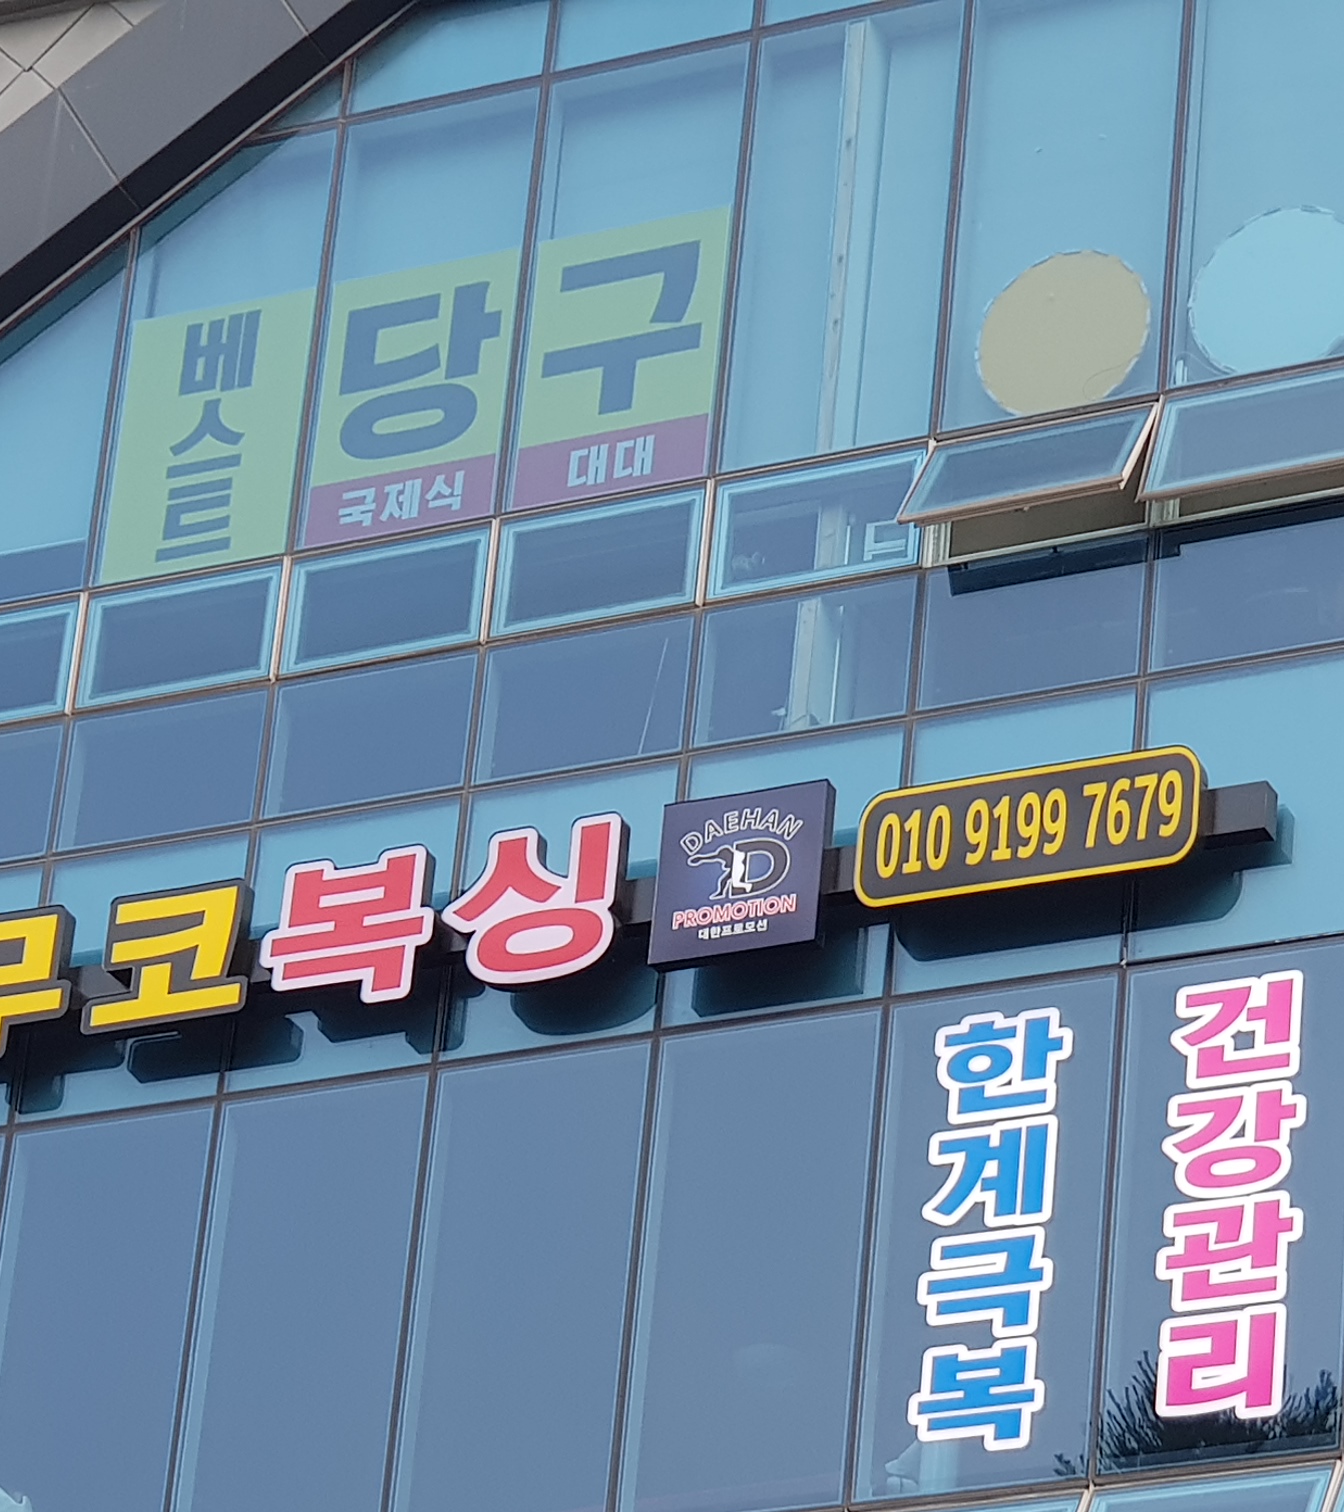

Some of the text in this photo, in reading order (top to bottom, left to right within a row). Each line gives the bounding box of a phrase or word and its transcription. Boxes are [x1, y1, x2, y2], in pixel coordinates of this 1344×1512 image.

[339, 239, 702, 460] 당구
[154, 308, 262, 563] 베스트
[567, 434, 655, 490] 대대
[337, 470, 465, 527] 국제식
[680, 807, 803, 856] DAEHAN
[876, 769, 1184, 879] 010 9199 7679
[672, 894, 797, 930] PROMOTION
[698, 919, 768, 940] 대한프로모션
[907, 1007, 1073, 1451] 한계극복
[1155, 969, 1306, 1420] 건강관리
